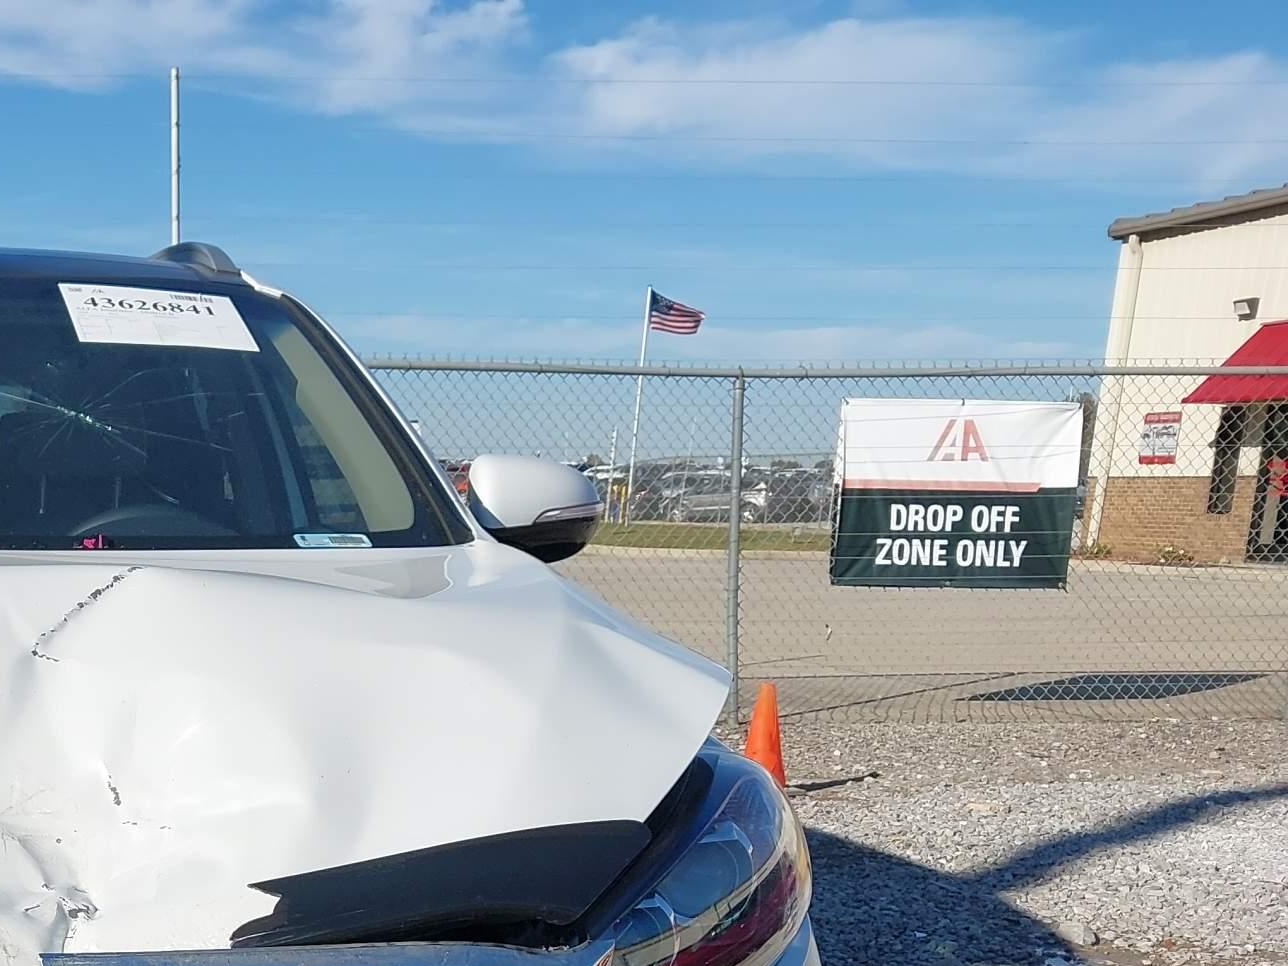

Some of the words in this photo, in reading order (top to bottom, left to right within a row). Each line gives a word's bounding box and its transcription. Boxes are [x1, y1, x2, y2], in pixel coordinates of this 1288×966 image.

[83, 296, 216, 316] 43626841
[890, 503, 963, 533] DROP
[971, 505, 1021, 533] OFF
[875, 538, 949, 566] ZONE
[956, 539, 1028, 568] ONLY
